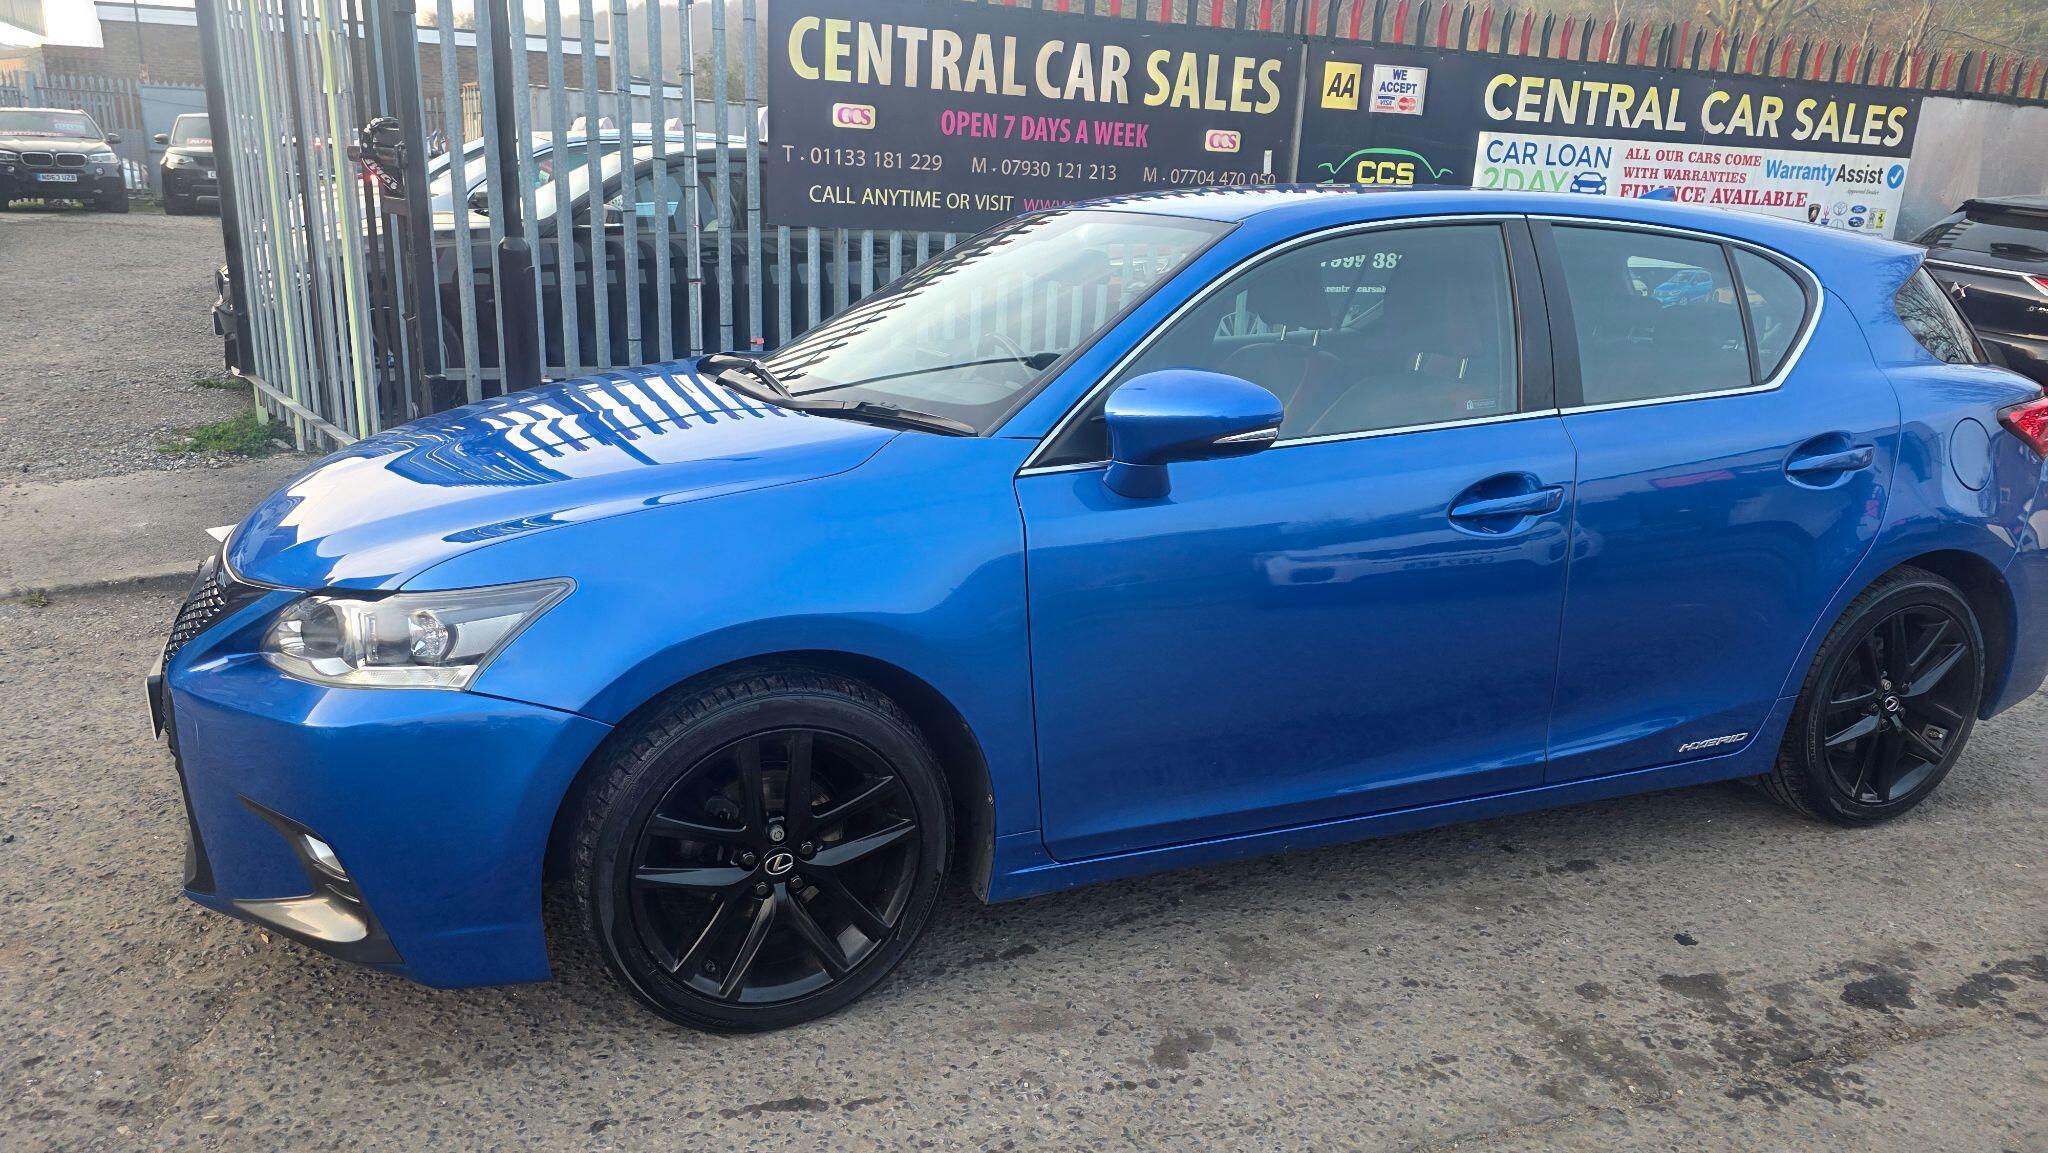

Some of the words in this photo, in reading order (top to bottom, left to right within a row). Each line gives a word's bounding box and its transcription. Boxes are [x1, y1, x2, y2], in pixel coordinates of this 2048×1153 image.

[788, 16, 1027, 97] CENTRAL
[1035, 40, 1131, 104] CAR
[1144, 50, 1282, 114] SALES
[1393, 69, 1408, 80] WE
[1327, 73, 1356, 98] AA
[1379, 81, 1418, 94] ACCEPT
[837, 106, 871, 125] CCS
[1484, 73, 1687, 132] CENTRAL
[1701, 90, 1784, 138] CAR
[1791, 98, 1908, 147] SALES
[941, 110, 998, 138] OPEN
[1004, 115, 1016, 139] 7
[1021, 115, 1071, 143] DAYS
[1075, 120, 1089, 144] A
[1094, 121, 1150, 148] WEEK
[1209, 132, 1238, 150] CCS
[810, 147, 866, 167] 01133
[874, 151, 902, 169] 181
[910, 153, 943, 171] 229
[1486, 139, 1539, 165] CAR
[1545, 143, 1613, 169] LOAN
[1625, 147, 1651, 161] ALL
[1655, 149, 1684, 163] OUR
[1688, 151, 1721, 165] CARS
[1724, 154, 1762, 167] COME
[1001, 159, 1051, 177] 07930
[1057, 162, 1082, 179] 121
[1089, 164, 1117, 181] 213
[1170, 168, 1215, 185] 07704
[1219, 171, 1246, 186] 470
[1356, 160, 1415, 184] CCS
[1483, 167, 1570, 193] 2DAY
[1623, 166, 1660, 180] WITH
[1663, 168, 1748, 184] WARRANTIES
[809, 185, 856, 204] CALL
[861, 187, 942, 209] ANYTIME
[946, 193, 970, 210] OR
[974, 194, 1014, 211] VISIT
[1709, 187, 1809, 208] AVAILABLE
[1678, 732, 1749, 752] HYBRID
